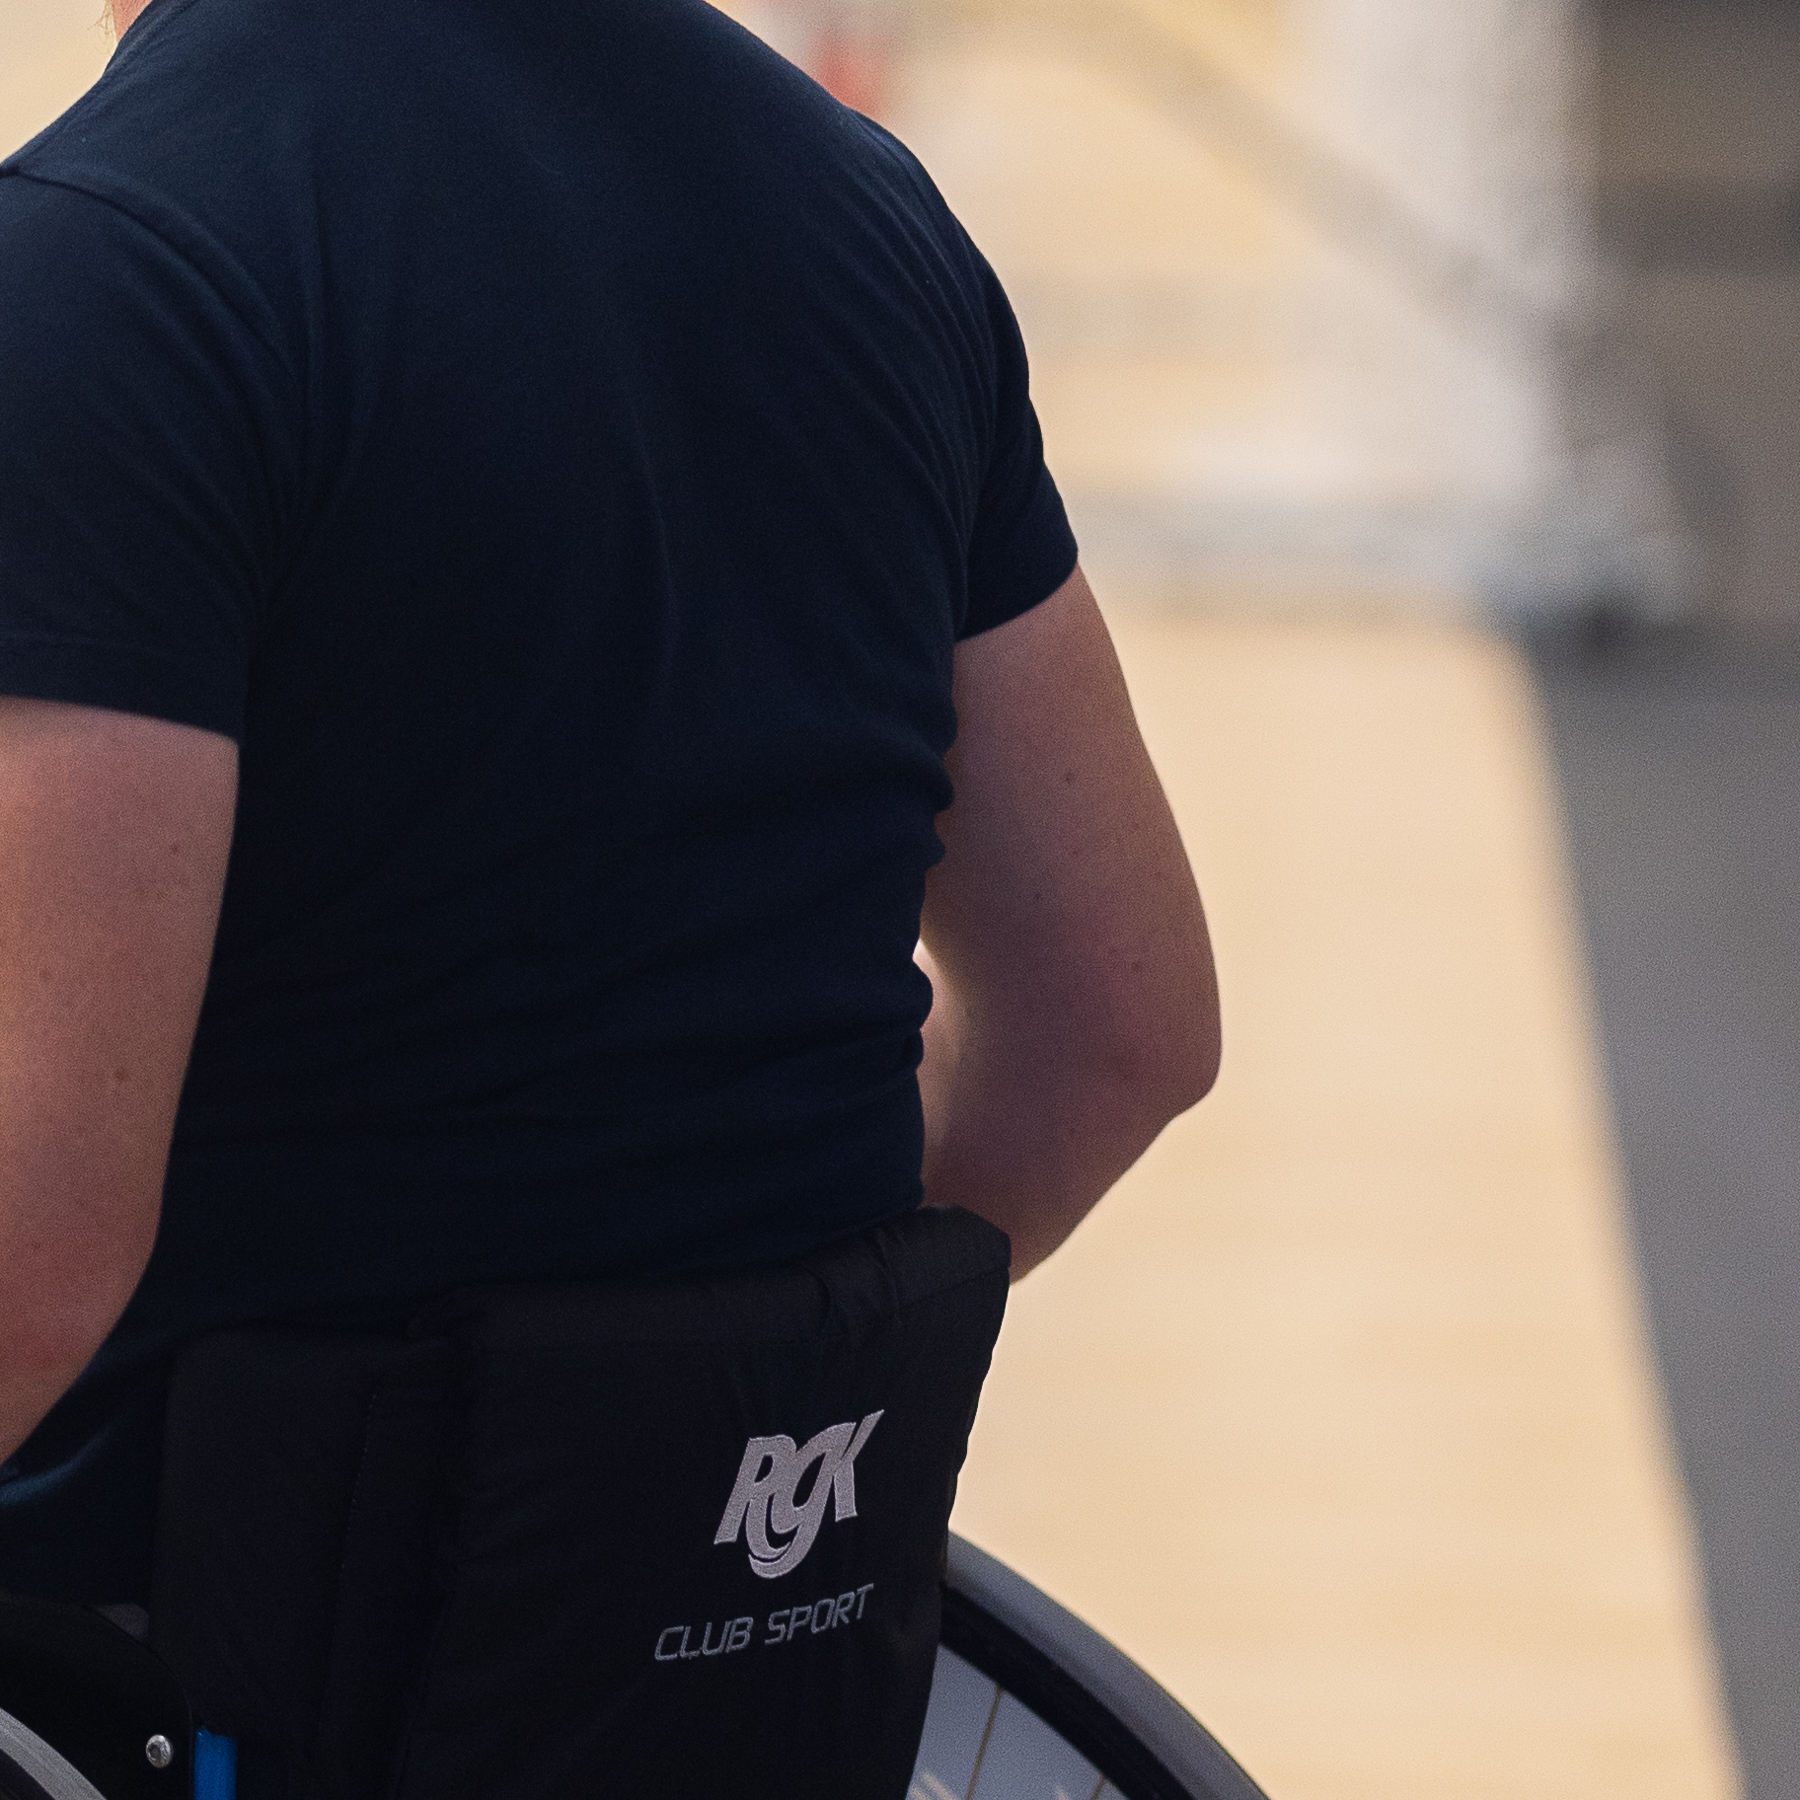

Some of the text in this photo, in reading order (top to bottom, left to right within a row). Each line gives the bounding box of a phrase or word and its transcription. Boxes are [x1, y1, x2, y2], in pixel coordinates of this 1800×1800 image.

[714, 1409, 884, 1578] RGK
[654, 1583, 874, 1661] CLUB SPORT
